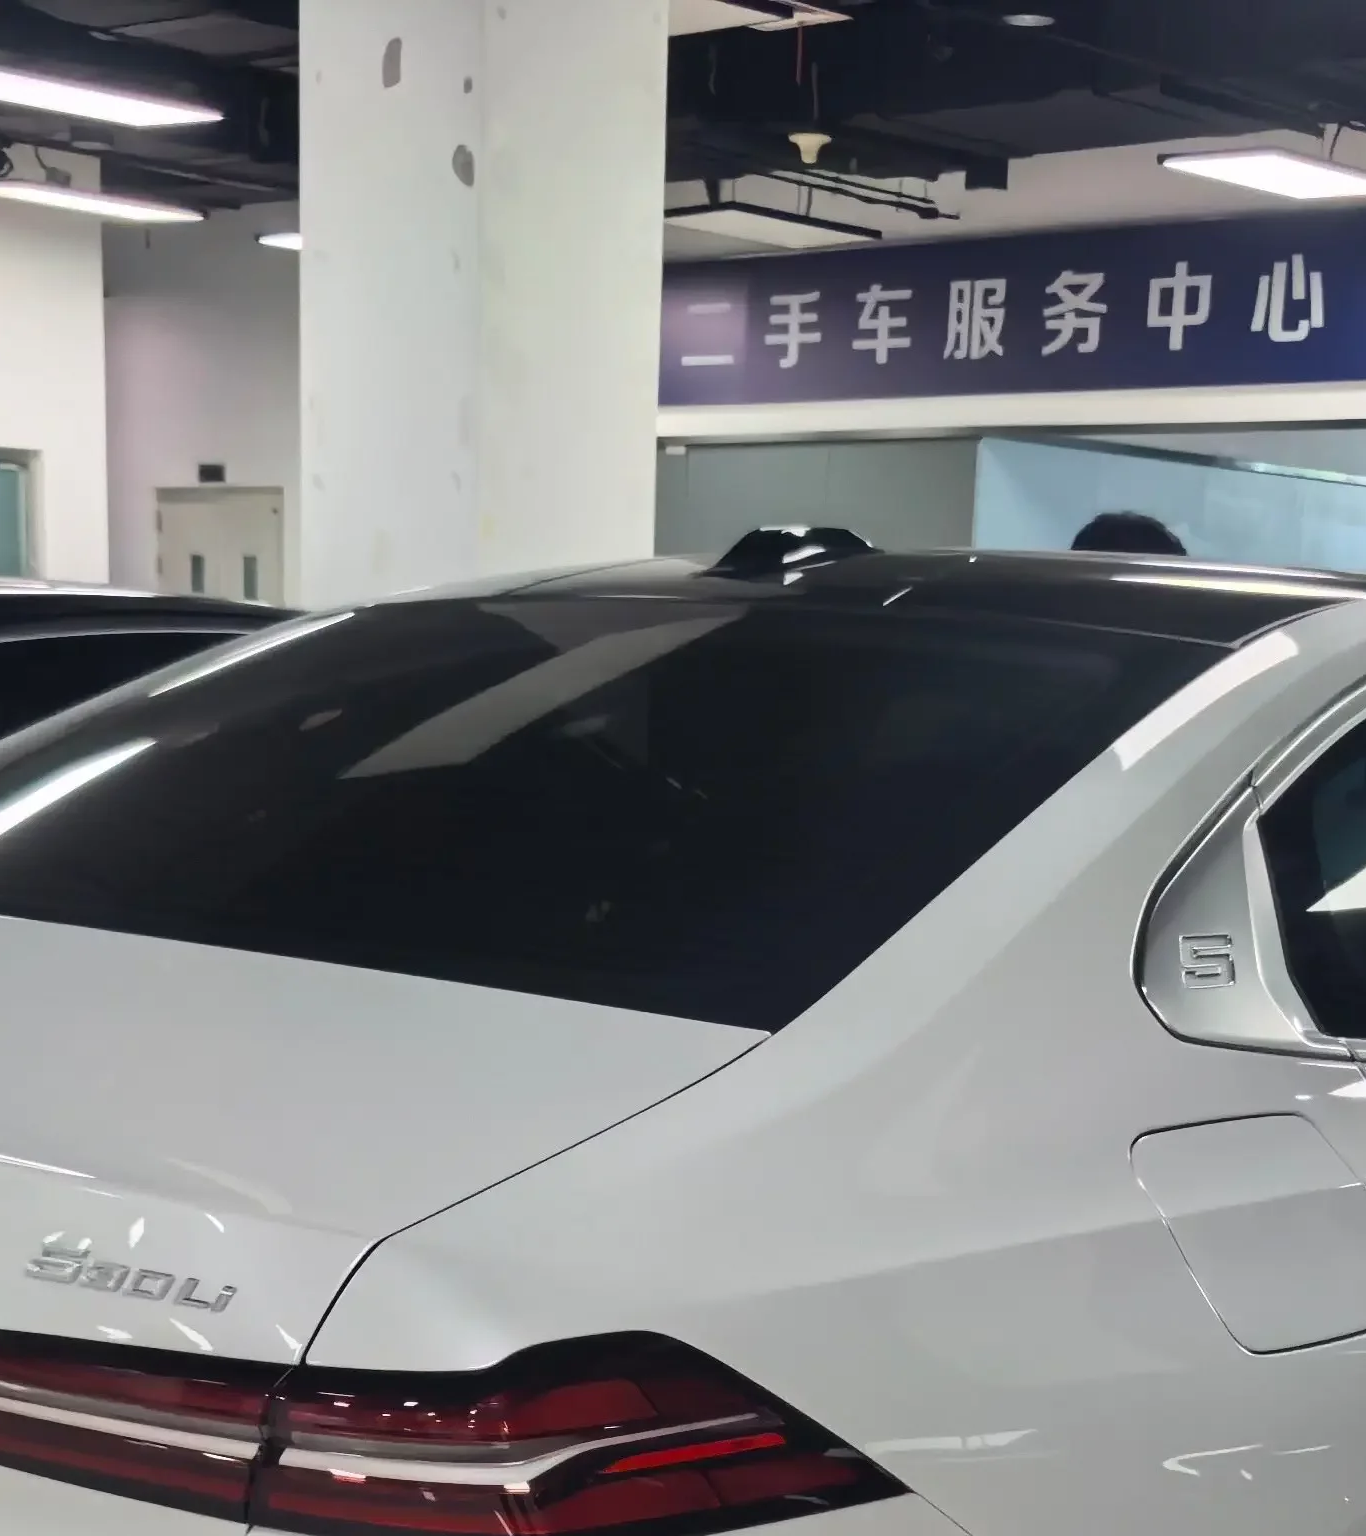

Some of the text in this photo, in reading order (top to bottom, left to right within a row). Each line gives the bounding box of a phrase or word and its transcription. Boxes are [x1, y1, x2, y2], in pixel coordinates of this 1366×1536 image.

[680, 253, 1326, 369] 二手车服务中心
